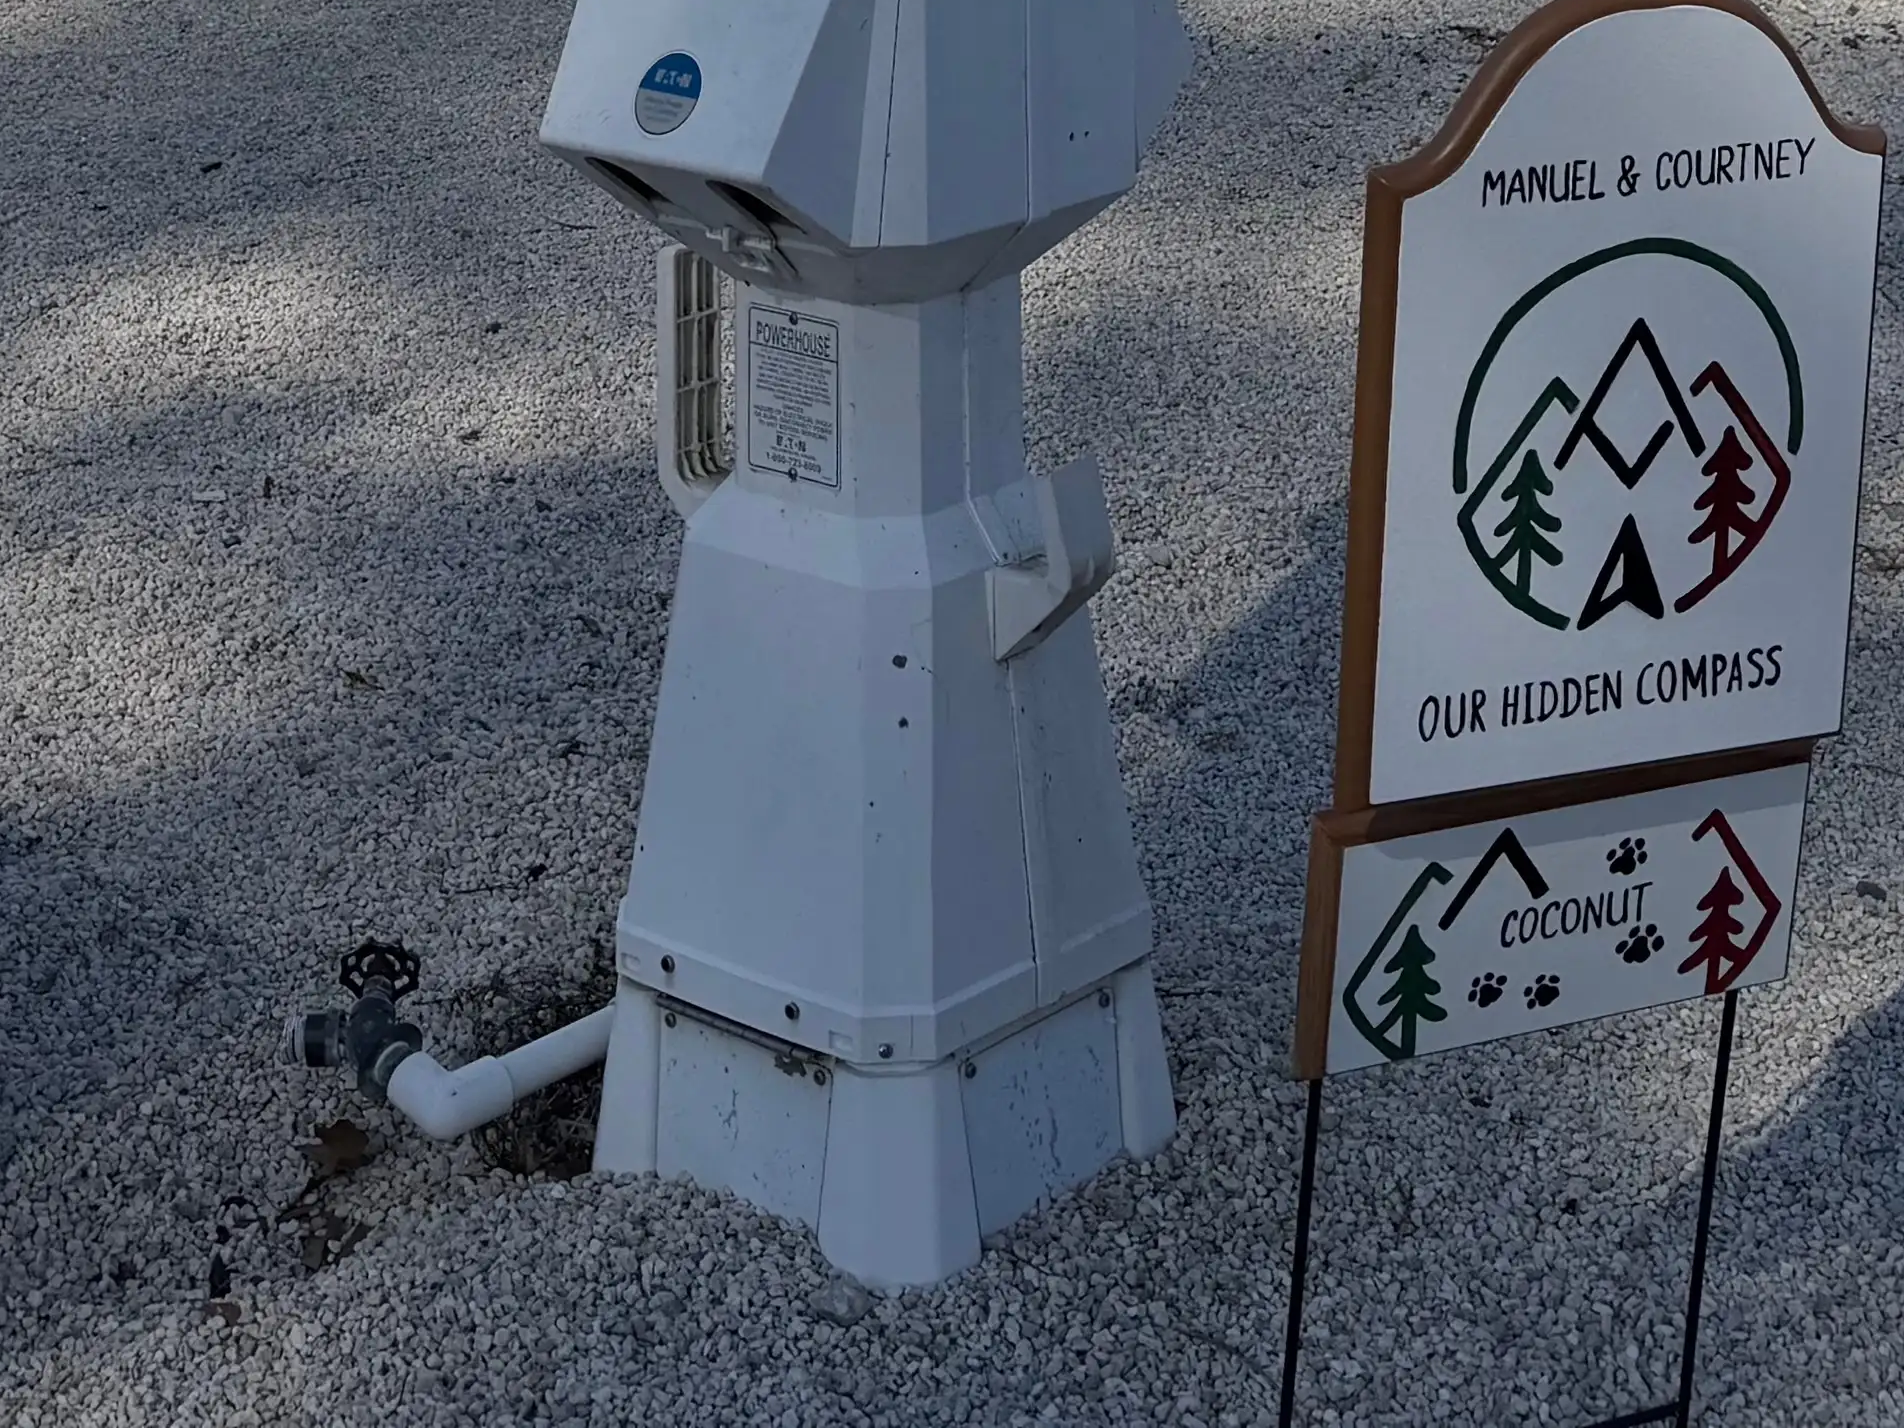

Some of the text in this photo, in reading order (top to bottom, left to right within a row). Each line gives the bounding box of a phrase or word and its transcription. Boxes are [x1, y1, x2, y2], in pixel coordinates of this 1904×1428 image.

[1482, 137, 1816, 208] MANUEL & COURTNEY
[756, 320, 831, 358] POWERHOUSE
[1417, 645, 1783, 742] OUR HIDDEN COMPASS
[1500, 881, 1654, 949] COCONUT
